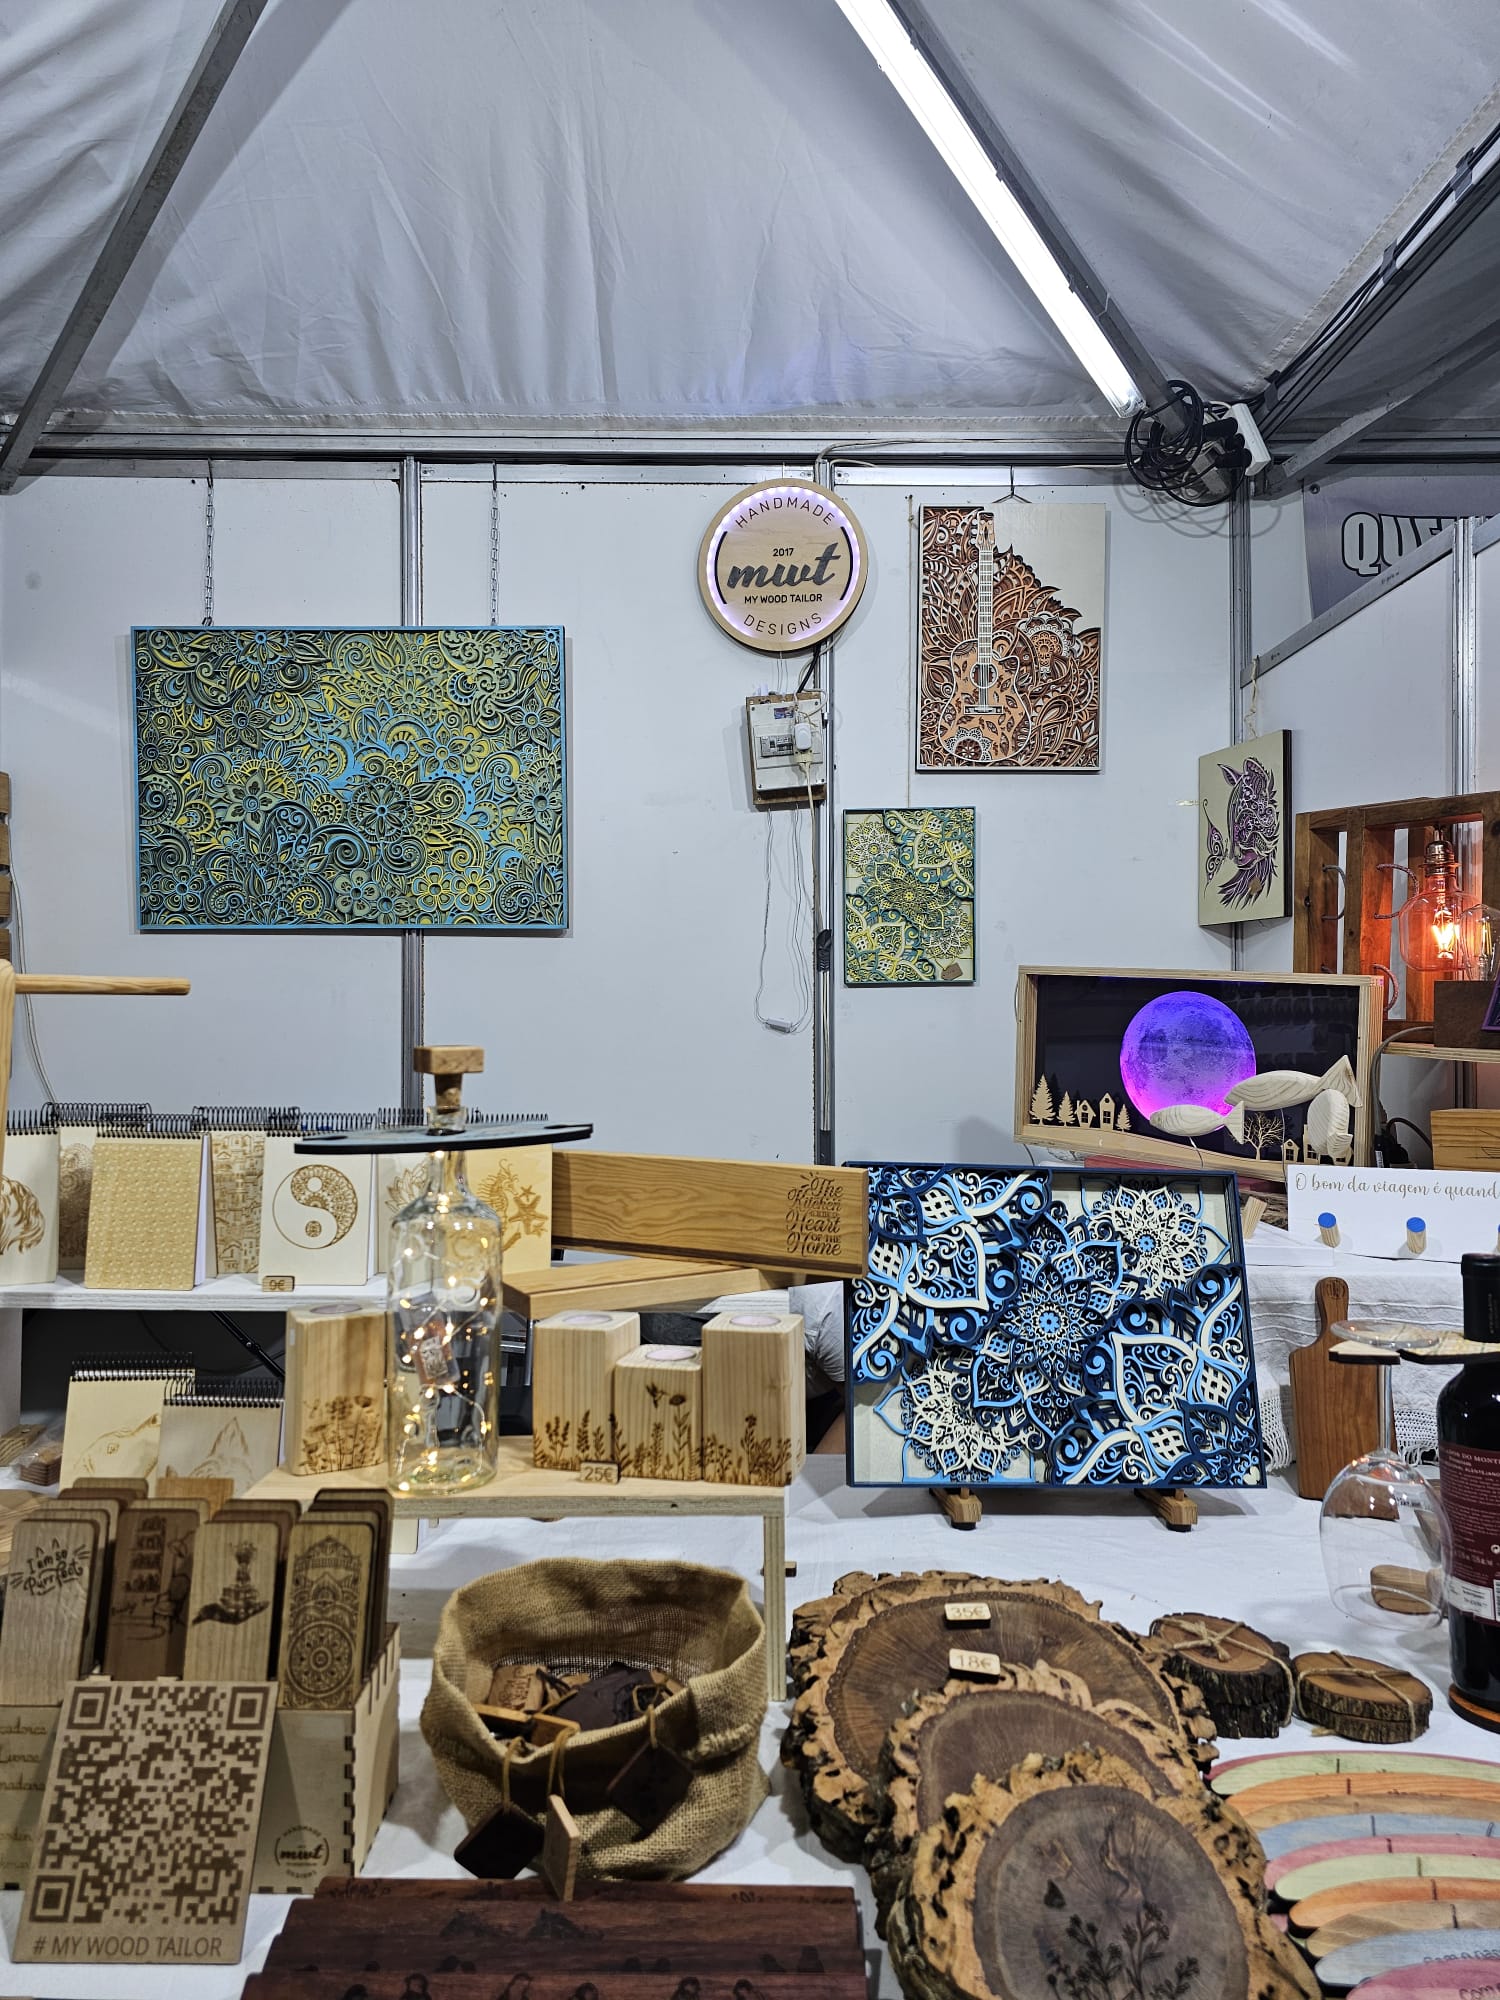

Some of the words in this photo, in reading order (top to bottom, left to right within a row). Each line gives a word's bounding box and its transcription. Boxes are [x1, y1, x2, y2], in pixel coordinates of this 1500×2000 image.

[735, 497, 835, 528] HANDMADE
[772, 548, 795, 557] 2017
[726, 542, 842, 589] mwt
[744, 595, 758, 604] MY
[760, 594, 788, 604] WOOD
[790, 593, 823, 603] TAILOR
[743, 612, 822, 635] DESIGNS
[810, 1175, 844, 1198] The
[1295, 1172, 1307, 1191] O
[1312, 1173, 1344, 1191] bom
[1347, 1174, 1370, 1192] da
[1373, 1180, 1430, 1199] viagem
[1433, 1181, 1441, 1195] é
[1445, 1180, 1500, 1201] quand
[787, 1188, 842, 1212] Kitchen
[785, 1208, 841, 1234] Heart
[786, 1232, 842, 1257] Home
[584, 1466, 614, 1483] 25€
[37, 1555, 53, 1569] am
[55, 1549, 68, 1561] so
[951, 1607, 985, 1617] 35€
[956, 1655, 992, 1669] 18€
[33, 1936, 47, 1954] #
[51, 1936, 82, 1956] MY
[87, 1936, 149, 1957] WOOD
[155, 1936, 223, 1958] TAILOR
